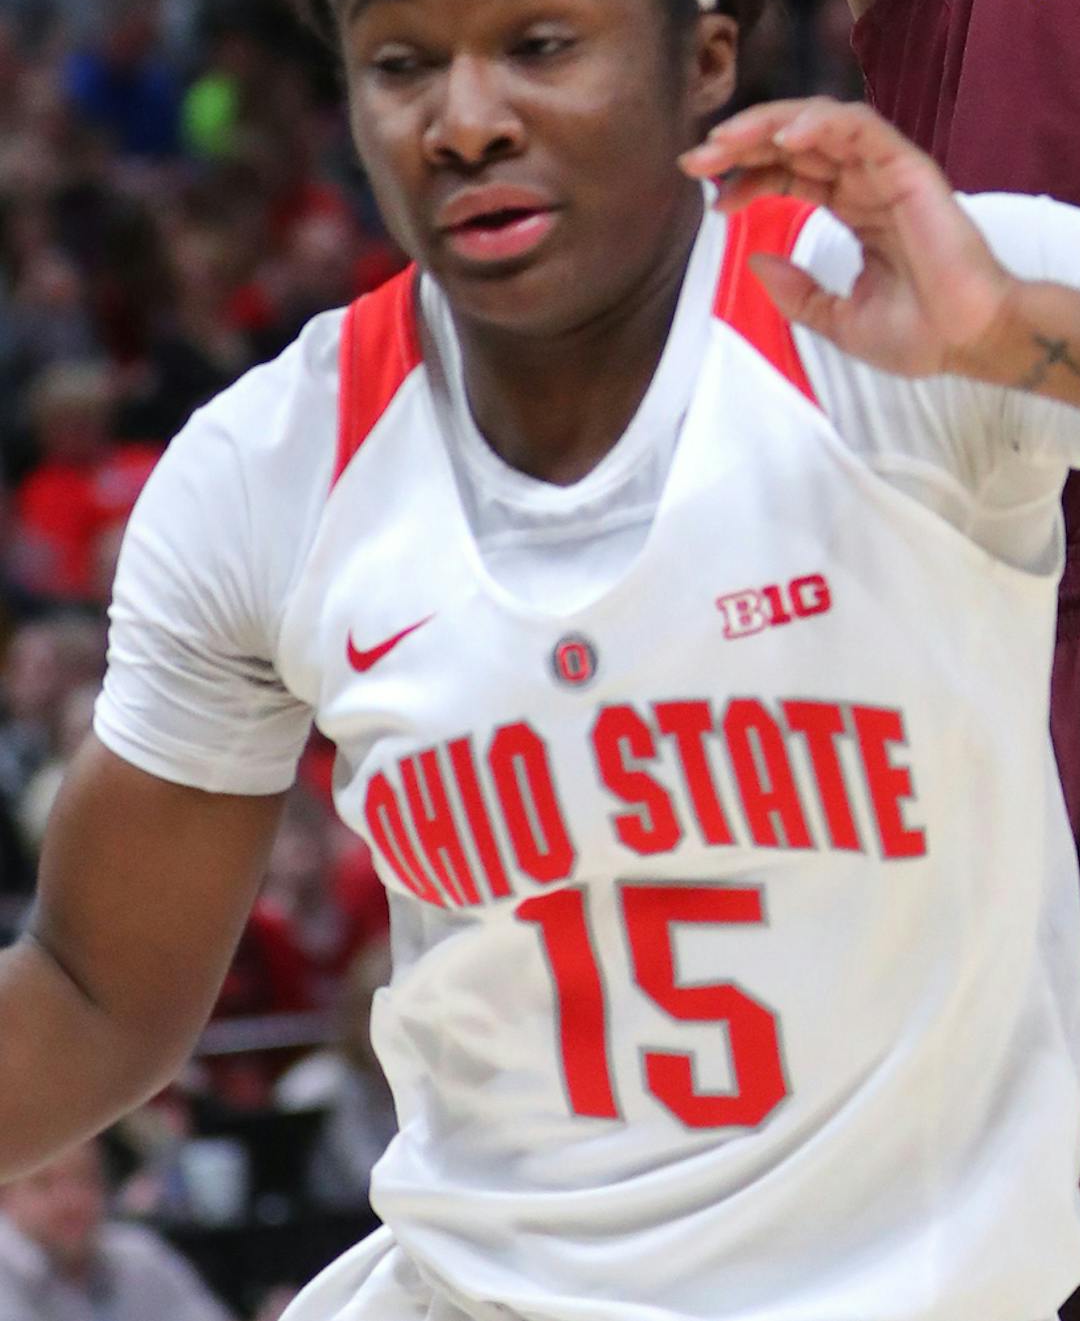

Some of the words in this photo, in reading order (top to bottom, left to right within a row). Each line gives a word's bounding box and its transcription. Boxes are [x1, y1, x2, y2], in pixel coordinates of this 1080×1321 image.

[364, 718, 578, 910] OHIO
[588, 696, 929, 861] STATE
[513, 878, 794, 1131] 15
